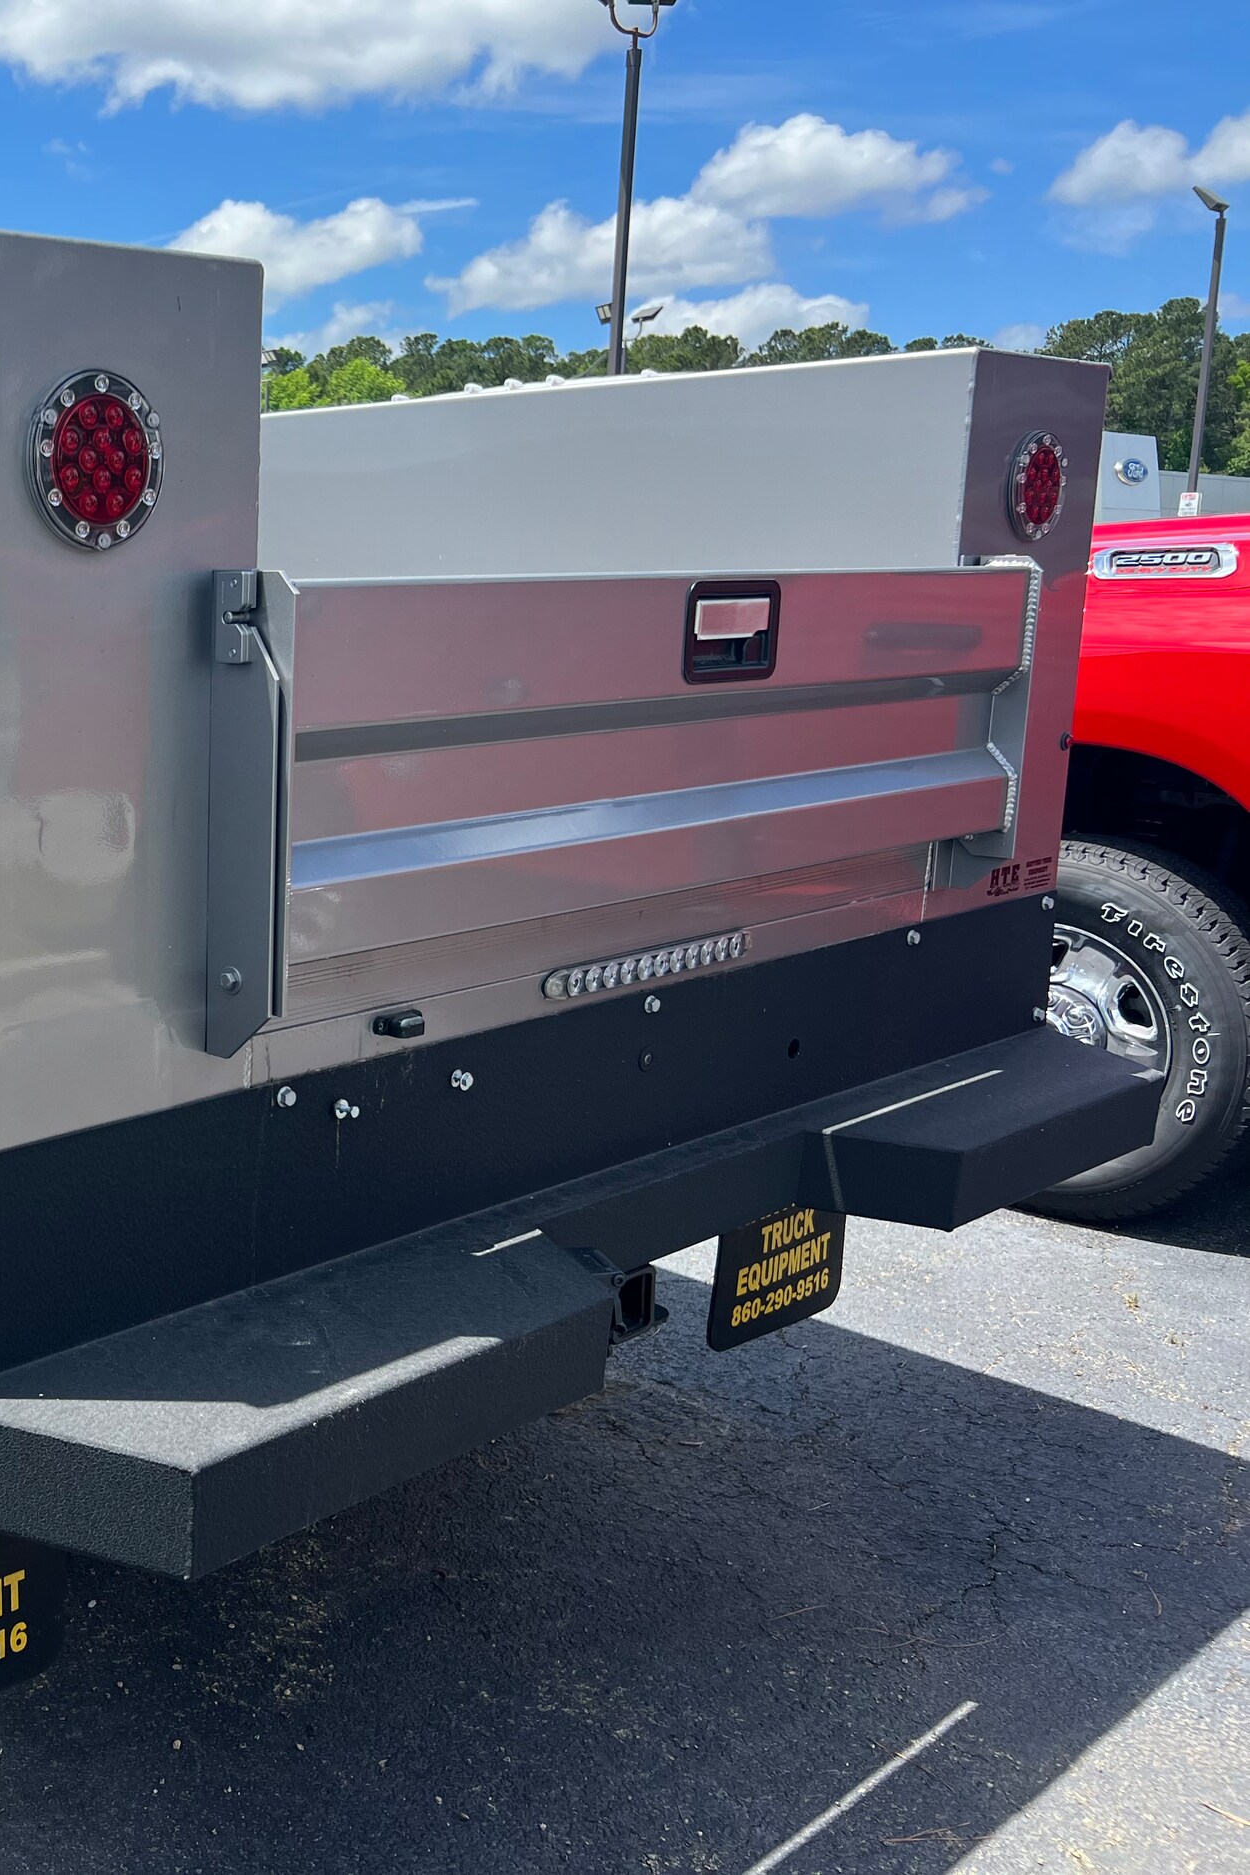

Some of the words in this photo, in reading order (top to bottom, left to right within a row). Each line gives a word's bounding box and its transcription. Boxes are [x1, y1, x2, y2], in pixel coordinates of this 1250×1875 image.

[1116, 552, 1213, 568] 2500
[990, 864, 1020, 889] HTE
[761, 1208, 815, 1254] TRUCK
[736, 1231, 831, 1297] EQUIPMENT
[731, 1267, 830, 1328] 860-290-9516
